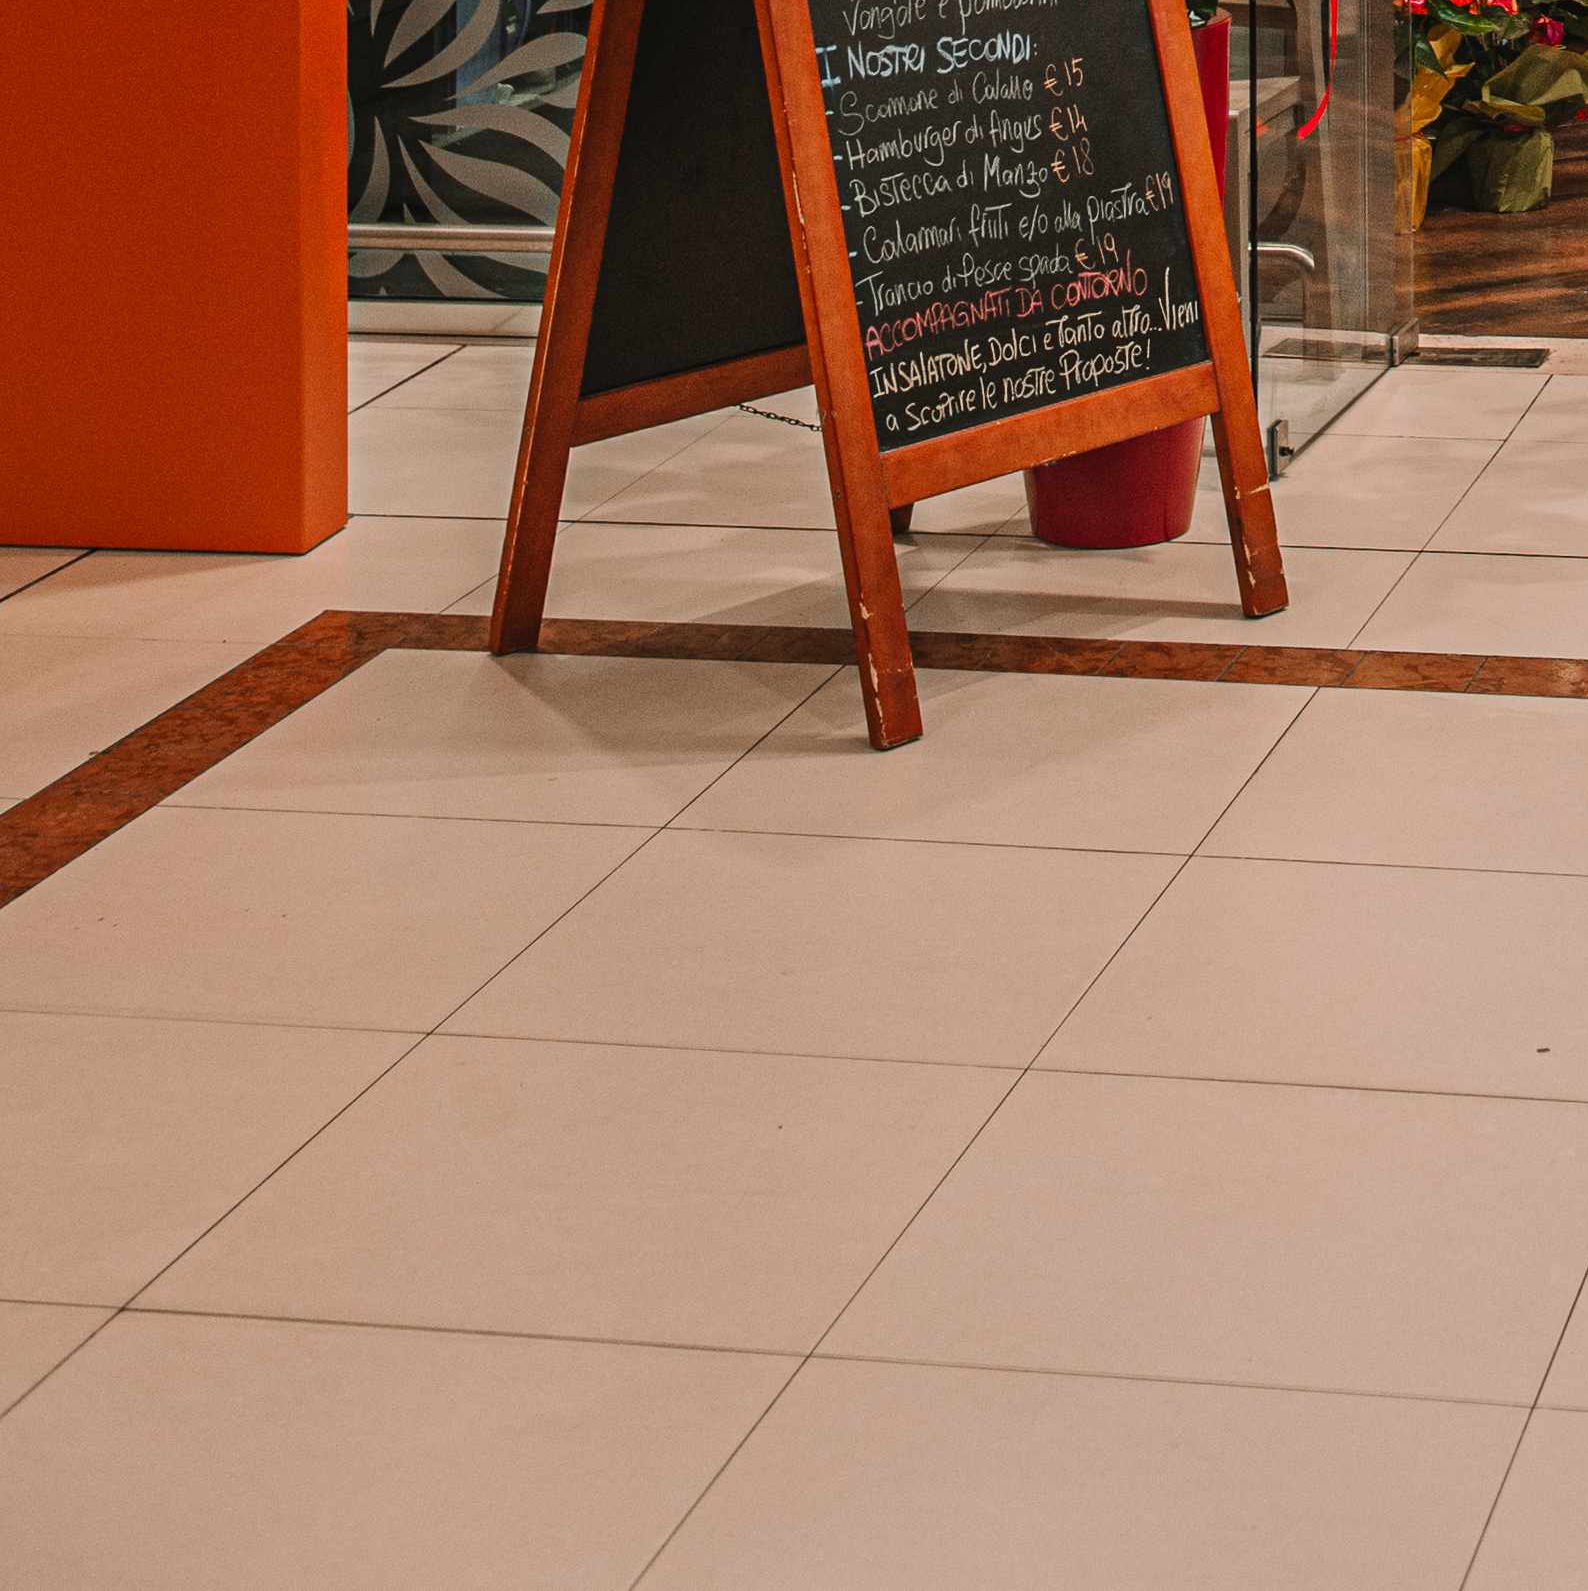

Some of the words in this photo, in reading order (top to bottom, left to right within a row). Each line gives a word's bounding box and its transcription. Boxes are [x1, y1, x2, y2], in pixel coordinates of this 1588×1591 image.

[815, 44, 842, 90] I
[847, 41, 926, 80] NOSTRI
[936, 28, 1039, 74] SECONDI:
[838, 88, 938, 136] Scamone
[947, 78, 964, 105] di
[845, 119, 962, 170] Hamburger
[965, 113, 984, 145] di
[956, 159, 975, 189] di
[984, 152, 1049, 199] Manzo
[862, 217, 963, 264] Calamari
[1018, 203, 1049, 242] e/o
[1054, 199, 1084, 233] alla
[854, 270, 935, 317] Trancio
[864, 285, 1012, 362] ACCOMPAGNATI
[1014, 286, 1045, 319] DA
[1050, 247, 1149, 311] CONTORNO
[885, 412, 901, 432] a
[979, 376, 998, 411] le
[1002, 366, 1057, 404] nostre
